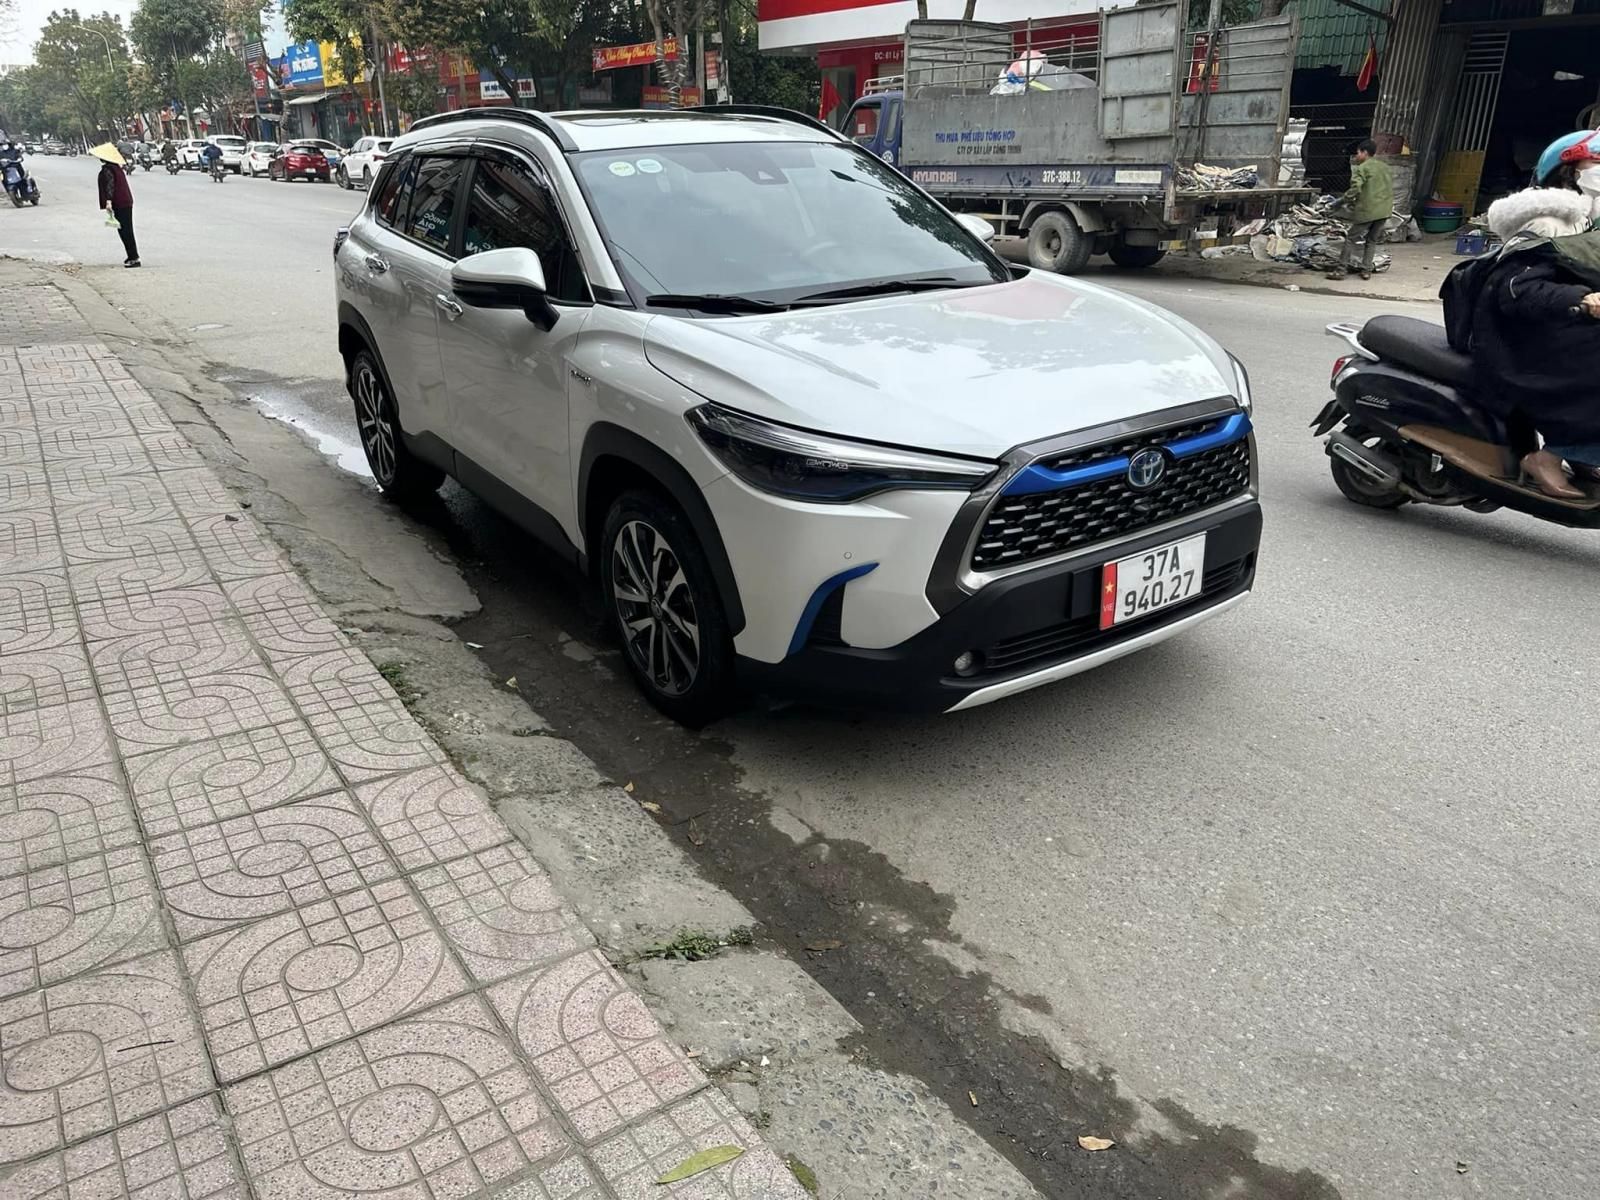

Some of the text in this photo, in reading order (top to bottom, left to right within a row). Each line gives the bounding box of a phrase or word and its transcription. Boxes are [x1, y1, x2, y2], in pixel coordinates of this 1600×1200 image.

[912, 170, 957, 183] HYUNDAI
[1142, 545, 1180, 582] 37A
[1123, 568, 1195, 617] 940.27
[1103, 602, 1114, 612] VIE
